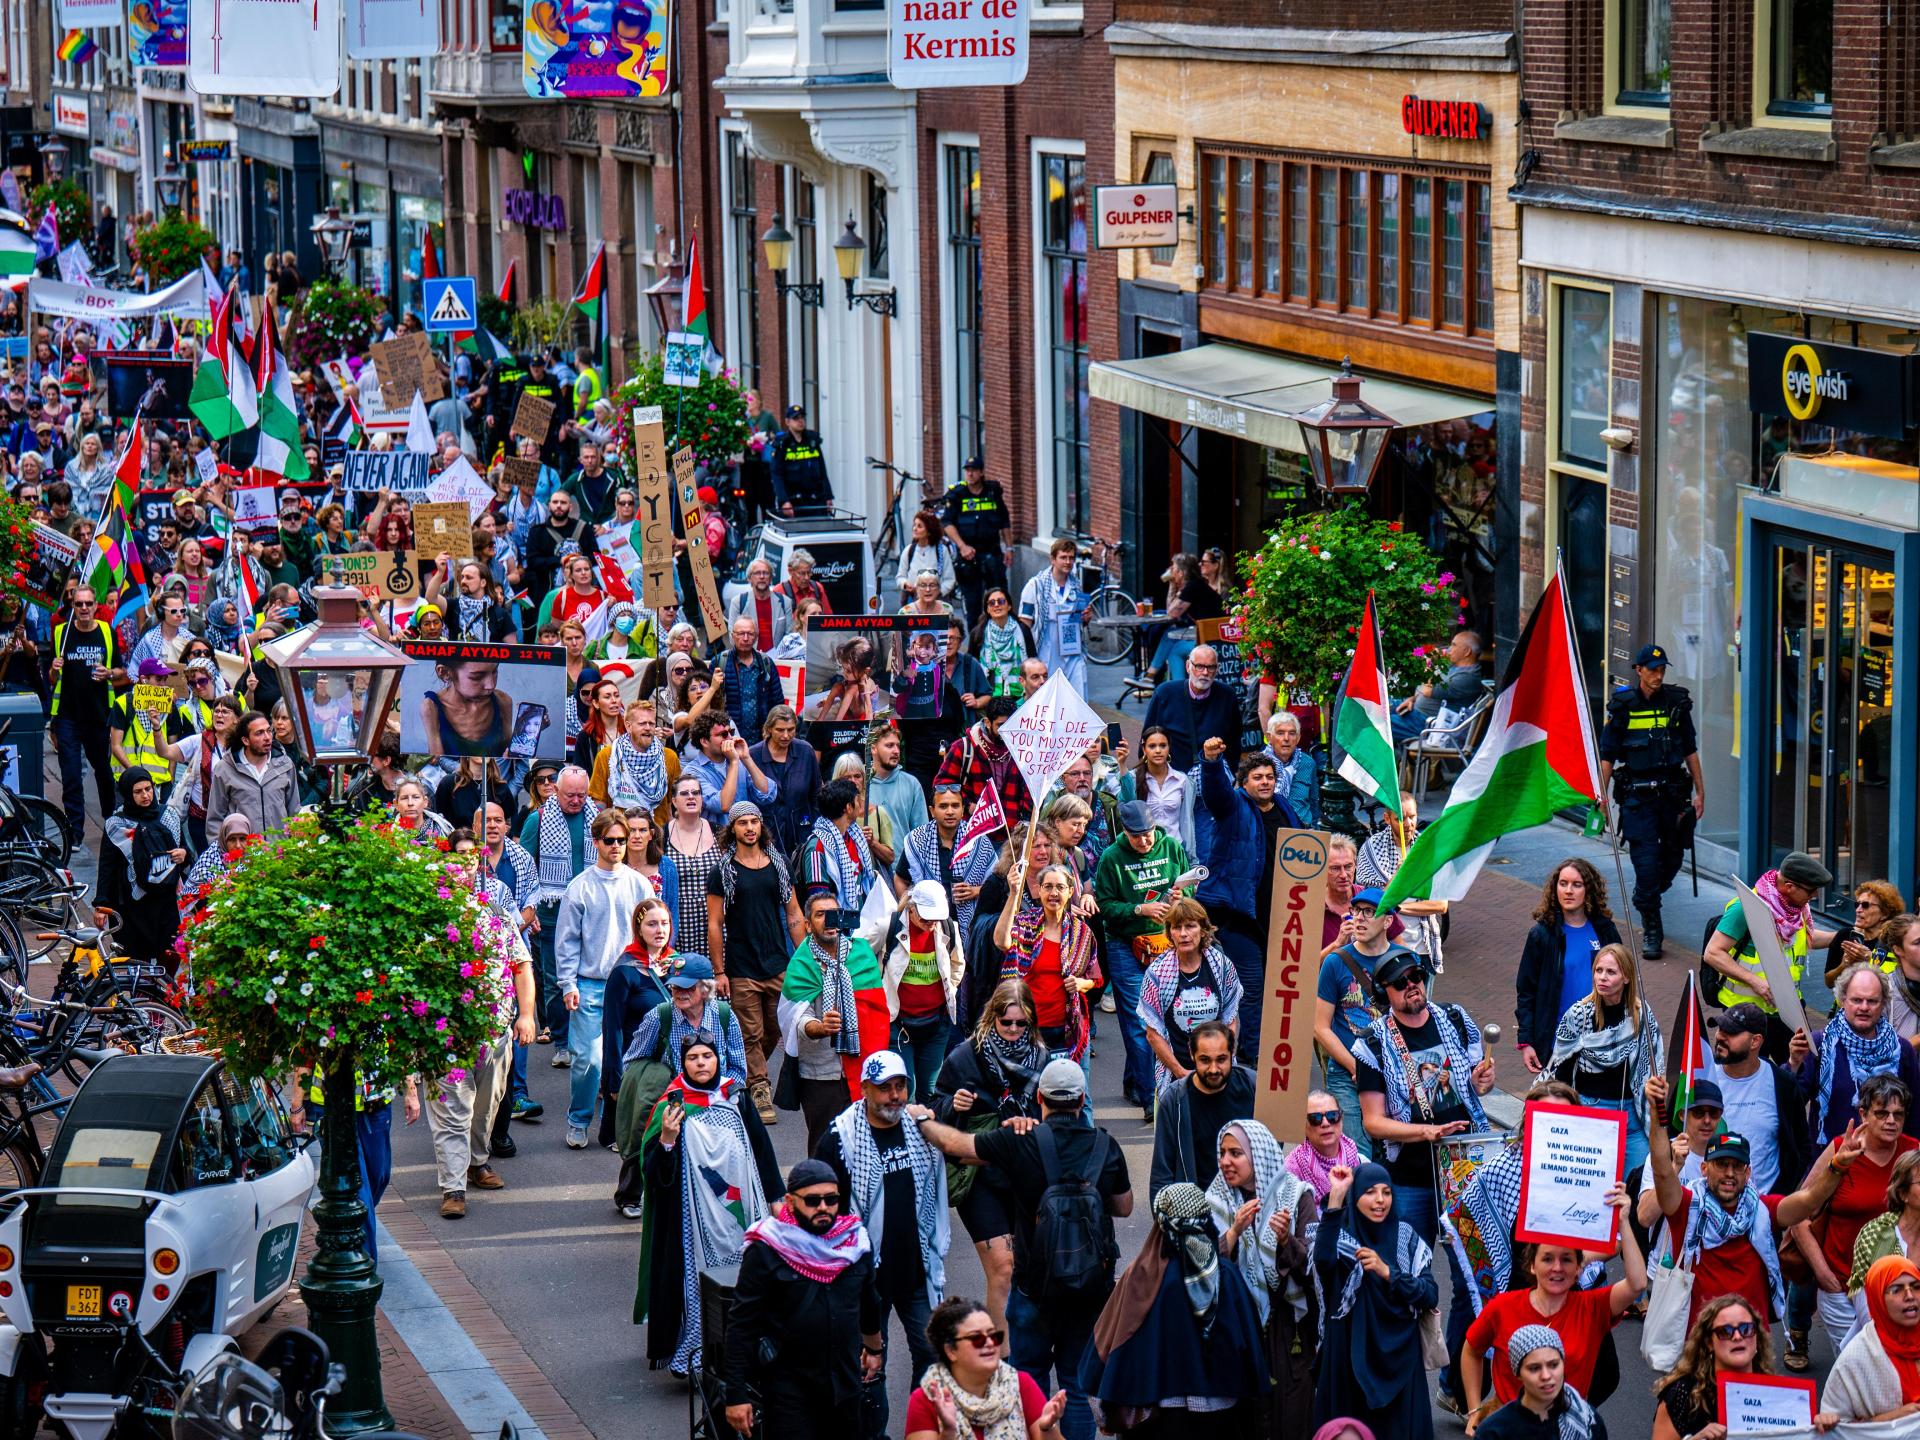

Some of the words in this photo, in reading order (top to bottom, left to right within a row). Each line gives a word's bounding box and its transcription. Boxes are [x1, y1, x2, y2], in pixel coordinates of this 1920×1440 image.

[904, 0, 973, 21] naar
[981, 0, 1018, 19] de
[903, 29, 1016, 60] Kermis
[1402, 95, 1478, 139] GULPENER
[503, 187, 566, 232] EKOPLAZA
[1106, 210, 1173, 225] GULPENER
[86, 295, 116, 309] BDS
[342, 452, 388, 490] NEVER
[388, 452, 430, 490] AGAIN
[641, 441, 665, 602] BOYCOTT
[820, 618, 851, 628] JANA
[854, 618, 893, 628] AYYAD
[916, 618, 930, 626] YR
[405, 644, 456, 657] RAHAF
[461, 646, 511, 659] AYYAD
[519, 650, 533, 659] 12
[534, 651, 552, 660] YR
[1035, 704, 1049, 718] IF
[1059, 707, 1065, 721] I
[1020, 717, 1056, 733] MUST
[1065, 721, 1088, 734] DIE
[1010, 731, 1034, 747] YOU
[1038, 735, 1072, 749] MUST
[1072, 738, 1093, 748] LIVE
[1018, 749, 1033, 762] TO
[1039, 751, 1061, 762] TELL
[1063, 750, 1080, 760] MY
[1027, 761, 1067, 776] STORY
[967, 803, 999, 831] ESTINE
[1143, 857, 1169, 868] AGAINST
[1282, 846, 1322, 865] DELL
[151, 853, 172, 874] NIK
[1138, 868, 1161, 881] ALL
[1133, 878, 1169, 890] GENOCIDES
[1269, 885, 1308, 1091] SANCTION
[1176, 1007, 1218, 1017] GENOCIDE
[1550, 1126, 1569, 1135] GAZA
[1547, 1141, 1561, 1150] VAN
[1562, 1144, 1602, 1155] WEGKIJKEN
[897, 1157, 912, 1170] GAZ
[1559, 1155, 1574, 1163] NOG
[1576, 1156, 1598, 1166] NOOIT
[198, 1169, 230, 1180] CARVER
[1540, 1163, 1568, 1173] IEMAND
[1569, 1167, 1606, 1178] SCHERPER
[1554, 1176, 1573, 1185] GAAN
[1574, 1179, 1591, 1188] ZIEN
[78, 1288, 99, 1300] FDT
[78, 1302, 98, 1313] 36Z
[113, 1298, 128, 1308] 45
[1743, 1397, 1762, 1407] GAZA
[1742, 1415, 1756, 1424] VAN
[1757, 1416, 1797, 1427] WEGKIJKEN
